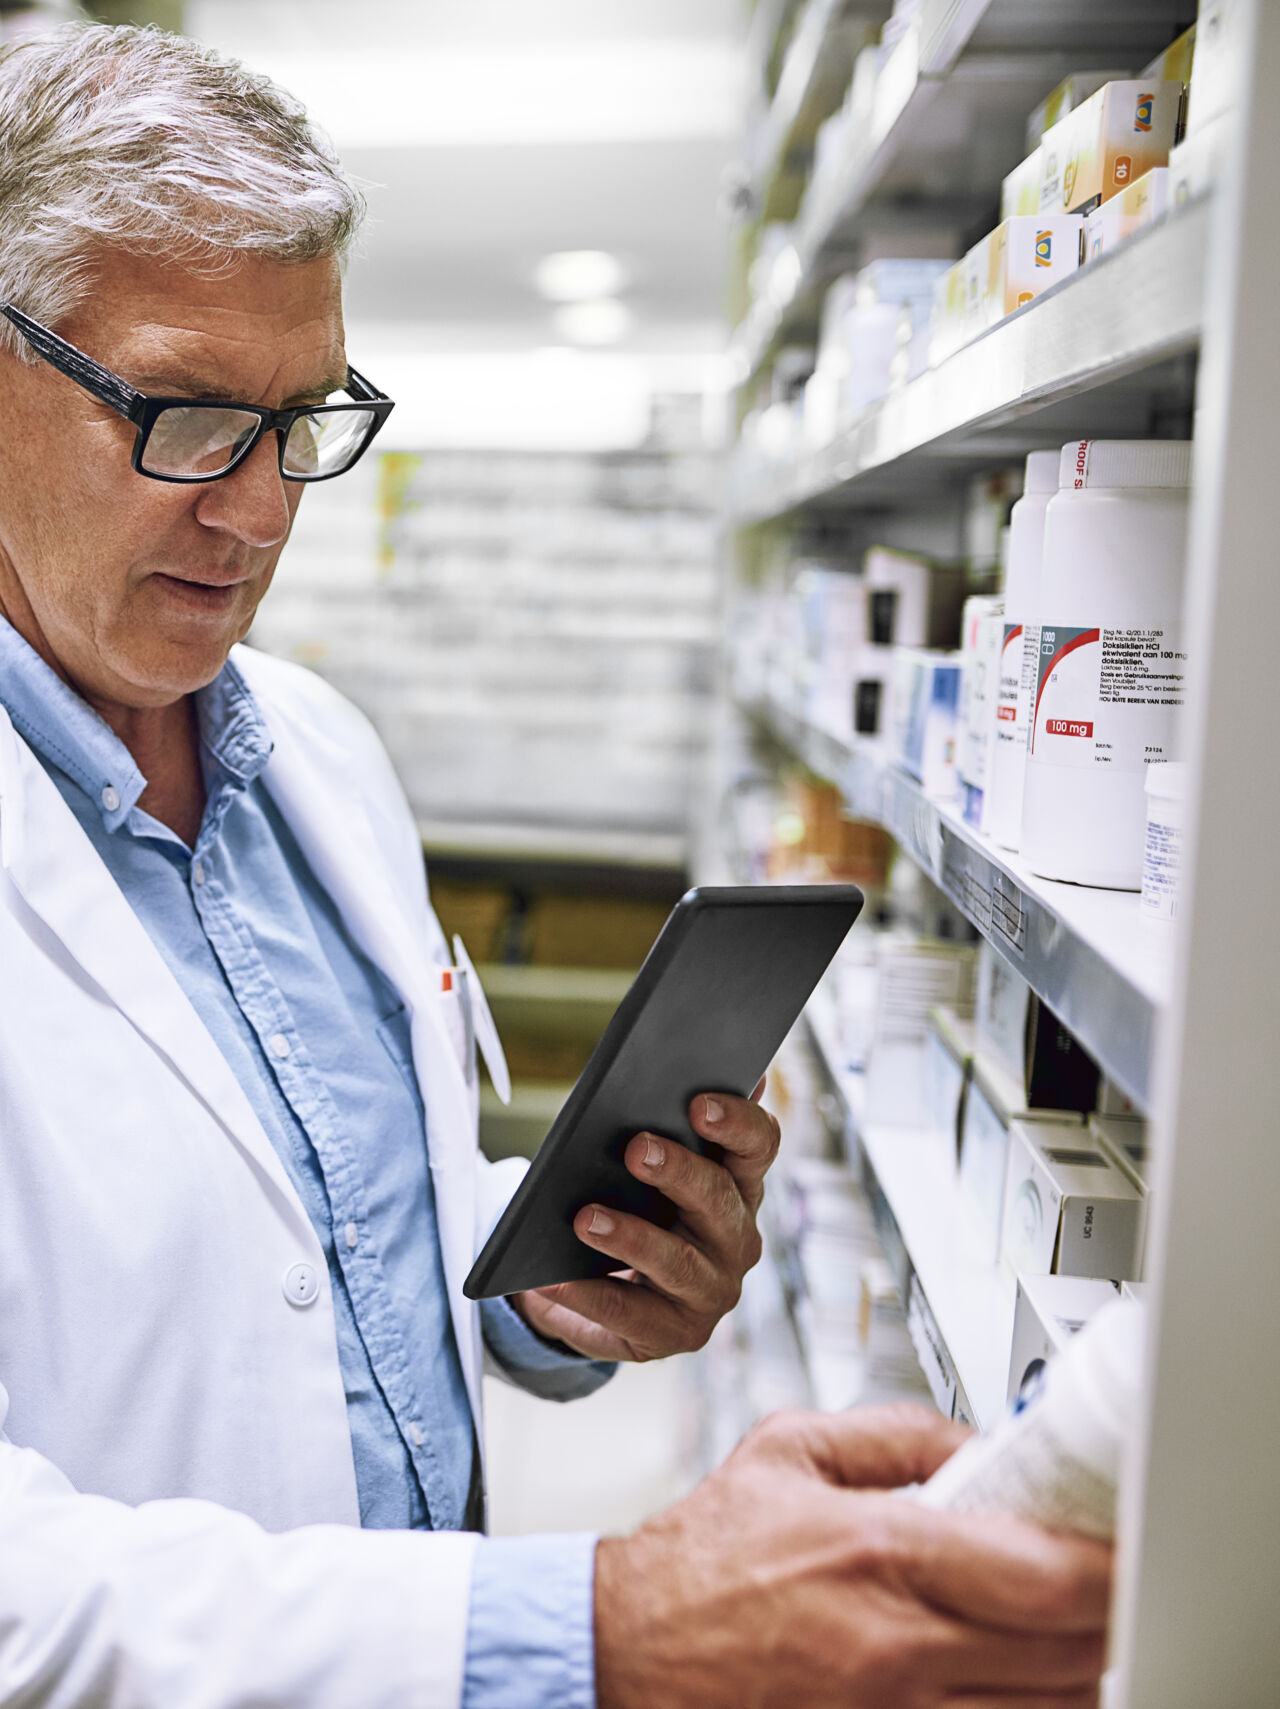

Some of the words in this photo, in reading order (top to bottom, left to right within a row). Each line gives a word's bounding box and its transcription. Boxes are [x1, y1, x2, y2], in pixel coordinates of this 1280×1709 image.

[1116, 164, 1128, 179] 10
[1076, 440, 1090, 475] ROOF
[1074, 478, 1083, 489] S
[1103, 642, 1144, 650] Doksisiklien
[1052, 721, 1066, 733] 100
[1069, 725, 1087, 736] mg
